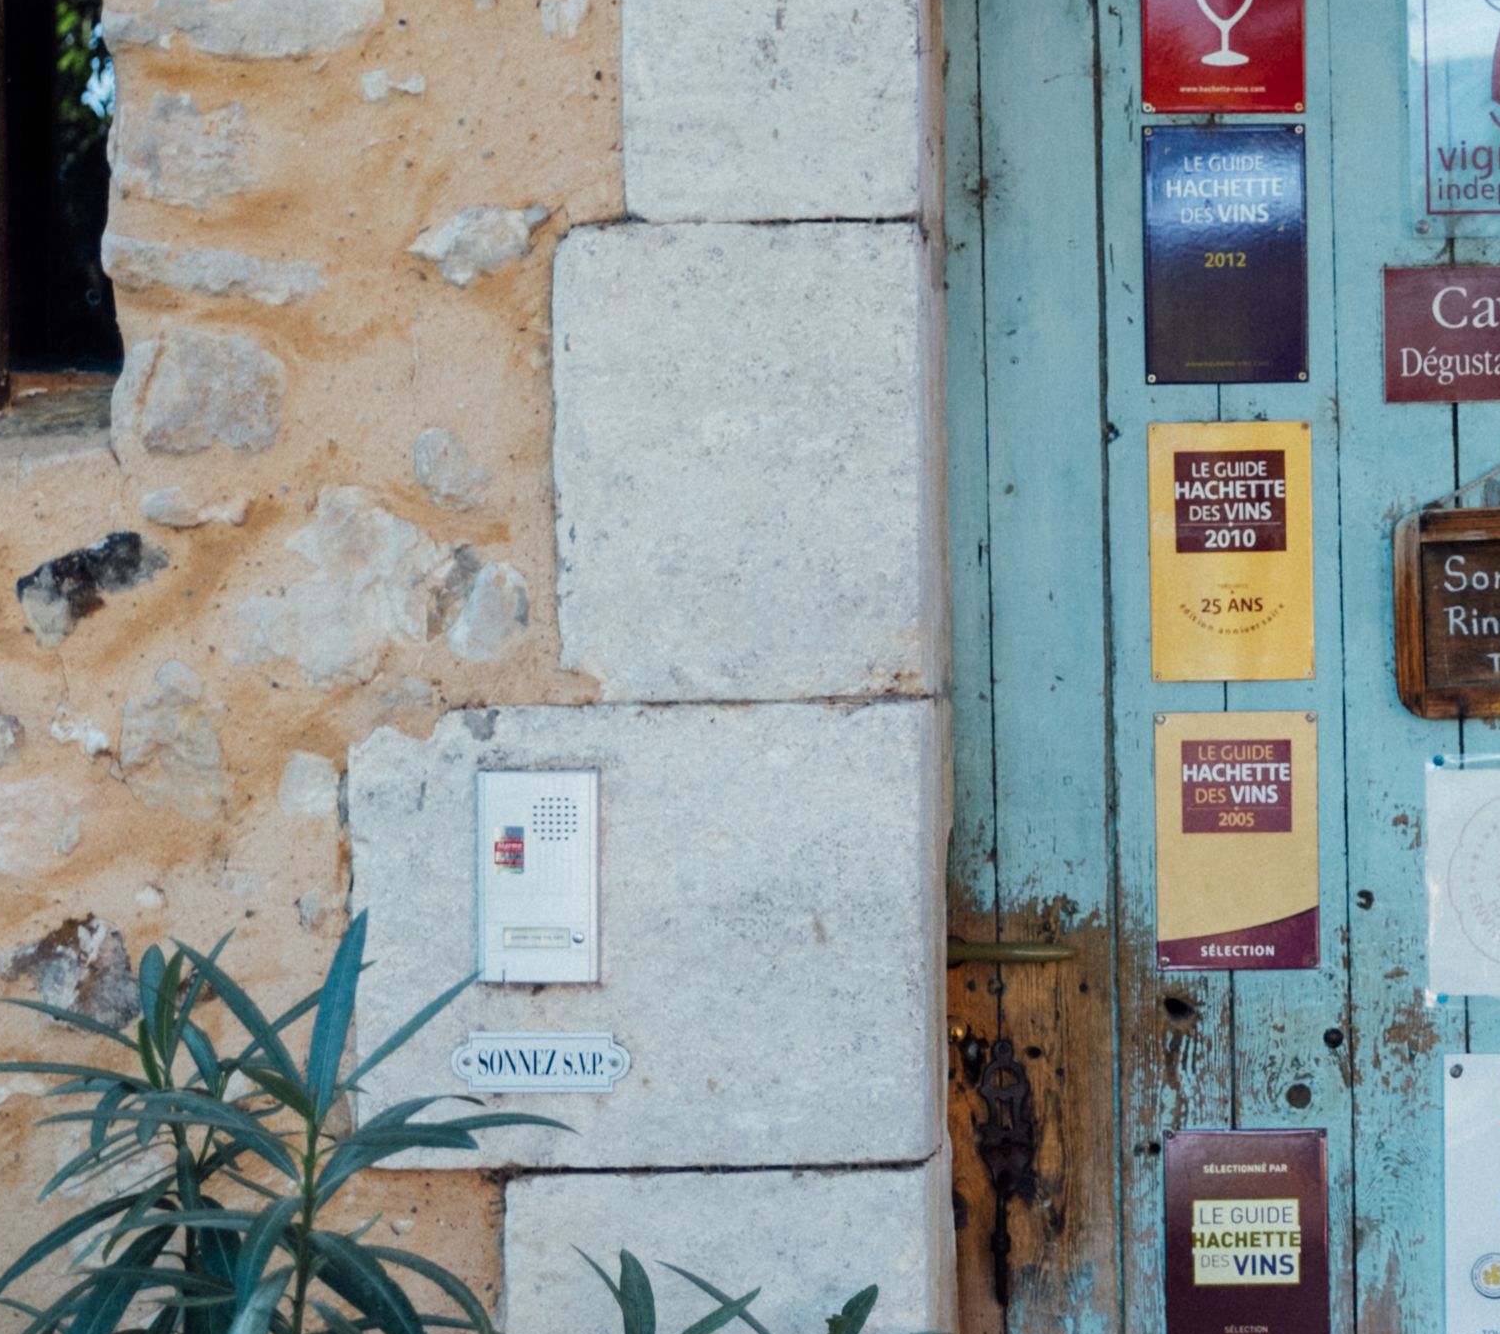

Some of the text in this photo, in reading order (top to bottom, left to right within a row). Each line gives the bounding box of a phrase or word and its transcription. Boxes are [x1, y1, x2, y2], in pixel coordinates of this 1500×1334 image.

[1184, 155, 1263, 172] LE GUIDE
[1166, 178, 1283, 198] HACHETTE
[1181, 203, 1268, 223] DES VINS
[1204, 253, 1246, 267] 2012
[1192, 461, 1267, 477] LE GUIDE
[1175, 480, 1285, 499] HACHETTE
[1190, 503, 1272, 521] DES VINS
[1205, 529, 1255, 548] 2010
[1202, 598, 1263, 614] 25 ANS
[1199, 745, 1273, 760] LE GUIDE
[1183, 763, 1290, 782] HACHETTE
[1195, 785, 1278, 803] DES VINS
[1219, 813, 1254, 827] 2005
[1201, 944, 1274, 956] SÉLECTION
[478, 1050, 603, 1076] SONNEZ S.V.P.
[1204, 1163, 1288, 1173] SÉLECTIONNÉ PAR
[1200, 1207, 1293, 1224] LE GUIDE
[1192, 1231, 1301, 1248] HACHETTE
[1201, 1255, 1294, 1276] DES VINS
